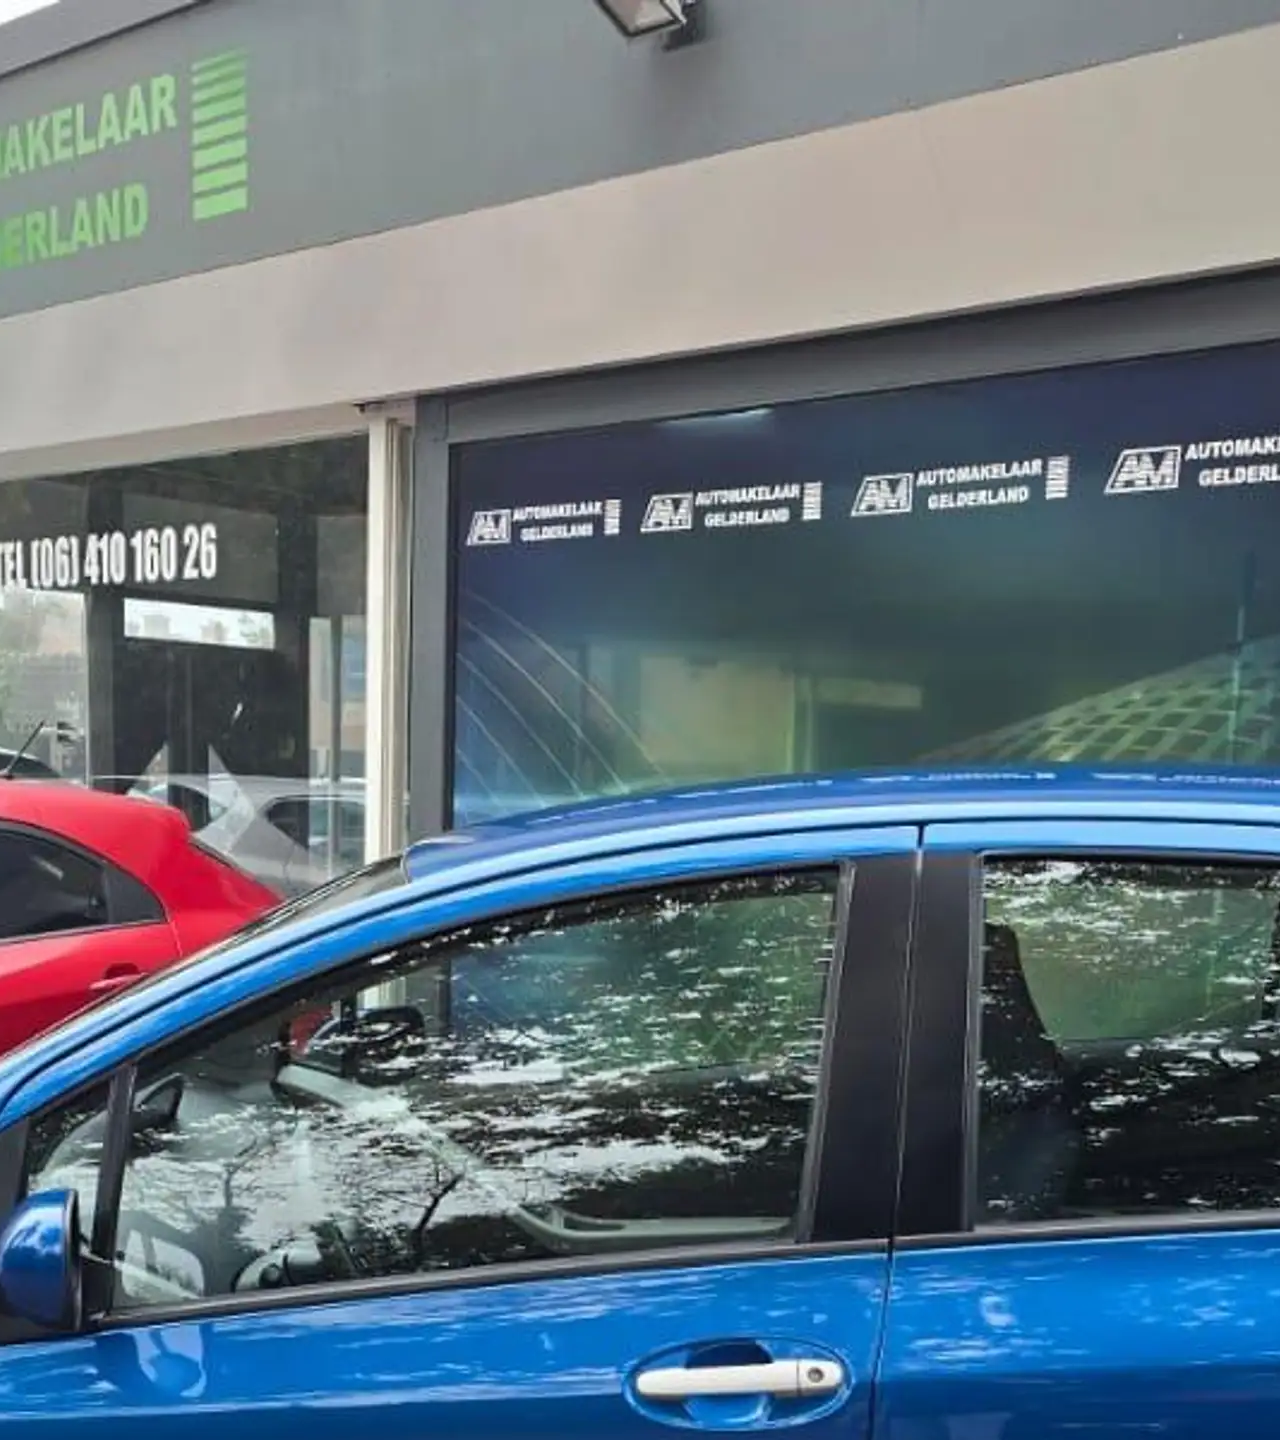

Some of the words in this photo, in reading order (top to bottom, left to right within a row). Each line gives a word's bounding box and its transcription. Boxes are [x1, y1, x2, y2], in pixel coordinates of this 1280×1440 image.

[916, 458, 1042, 486] AUTOMAKELAAR
[694, 484, 801, 507] AUTOMAKELAAR
[928, 485, 1029, 510] GELDERLAND
[703, 506, 790, 528] GELDERLAND
[84, 531, 126, 586] 410
[130, 524, 178, 584] 160
[182, 521, 218, 581] 26
